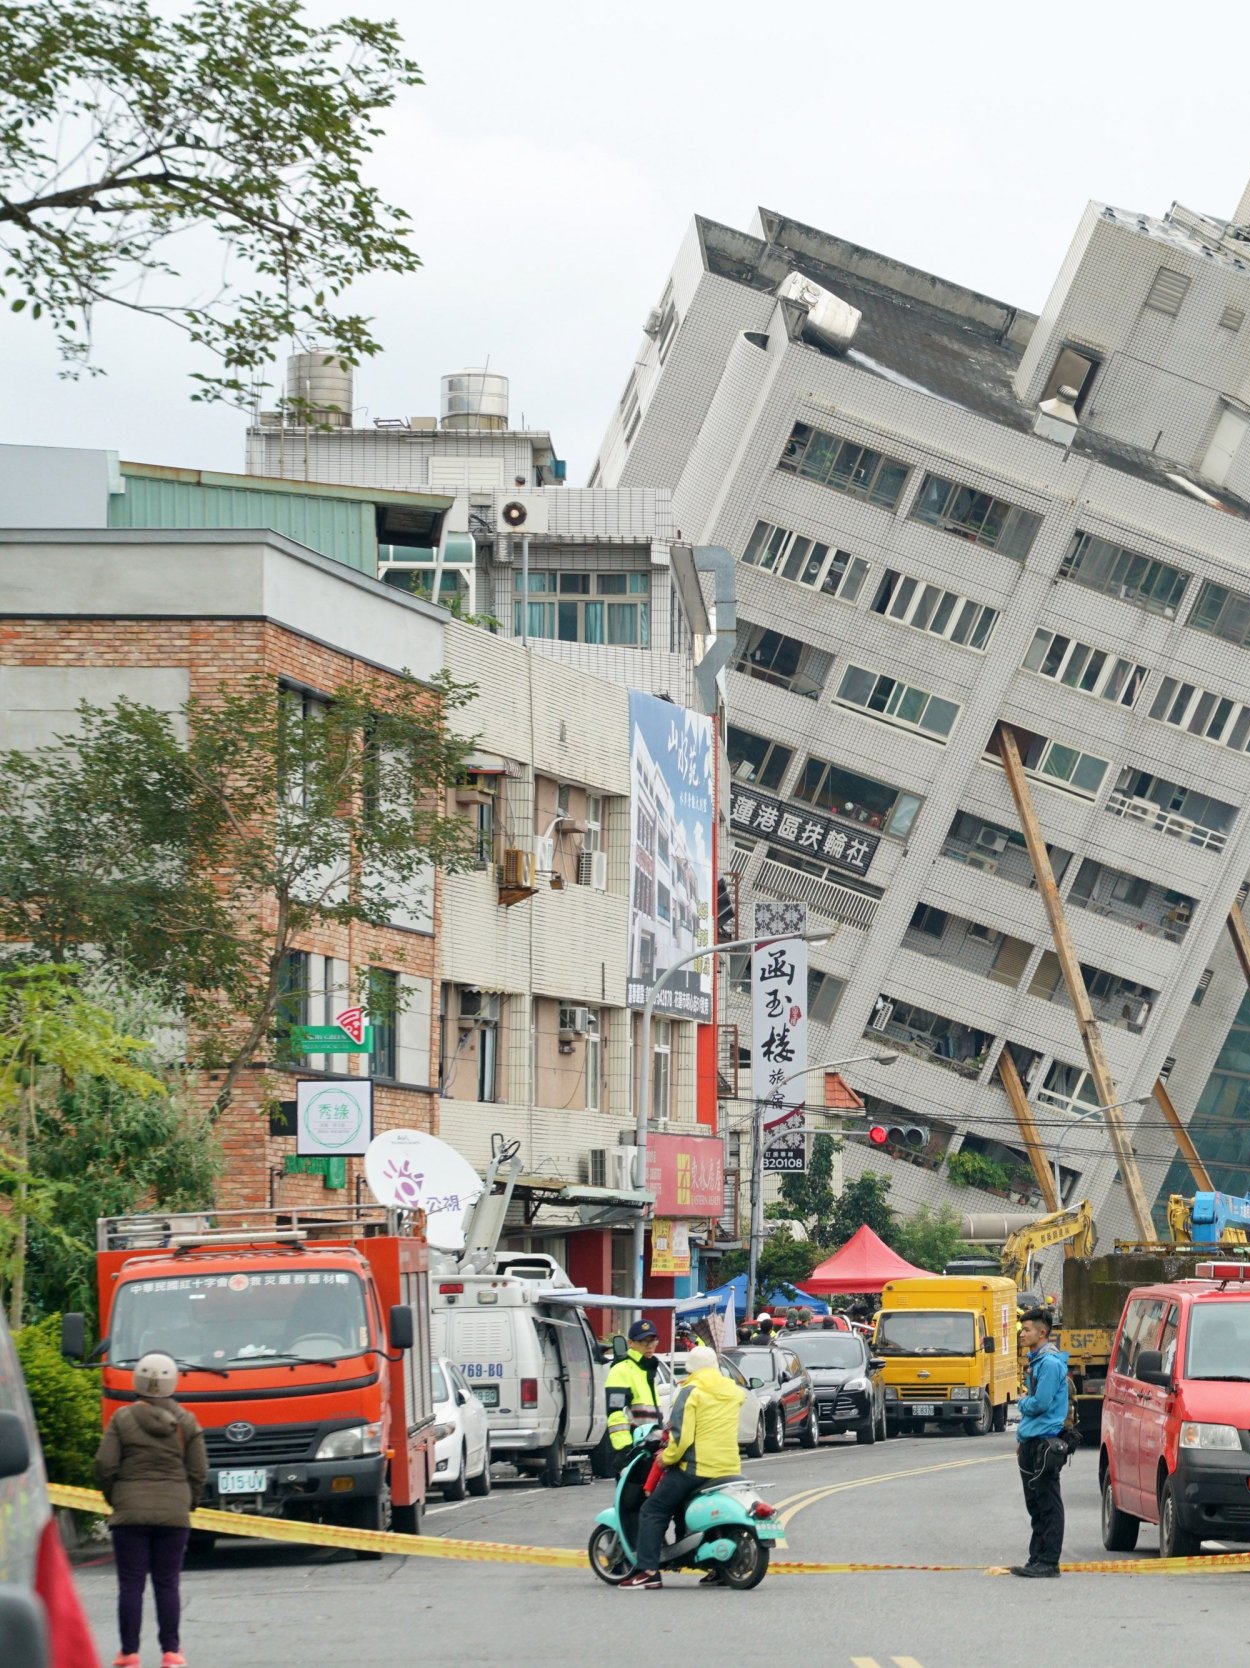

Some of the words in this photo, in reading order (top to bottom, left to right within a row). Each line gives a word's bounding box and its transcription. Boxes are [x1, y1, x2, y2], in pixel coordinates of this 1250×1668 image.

[729, 794, 869, 867] 蓮港區扶輪社
[426, 1195, 462, 1213] 公視
